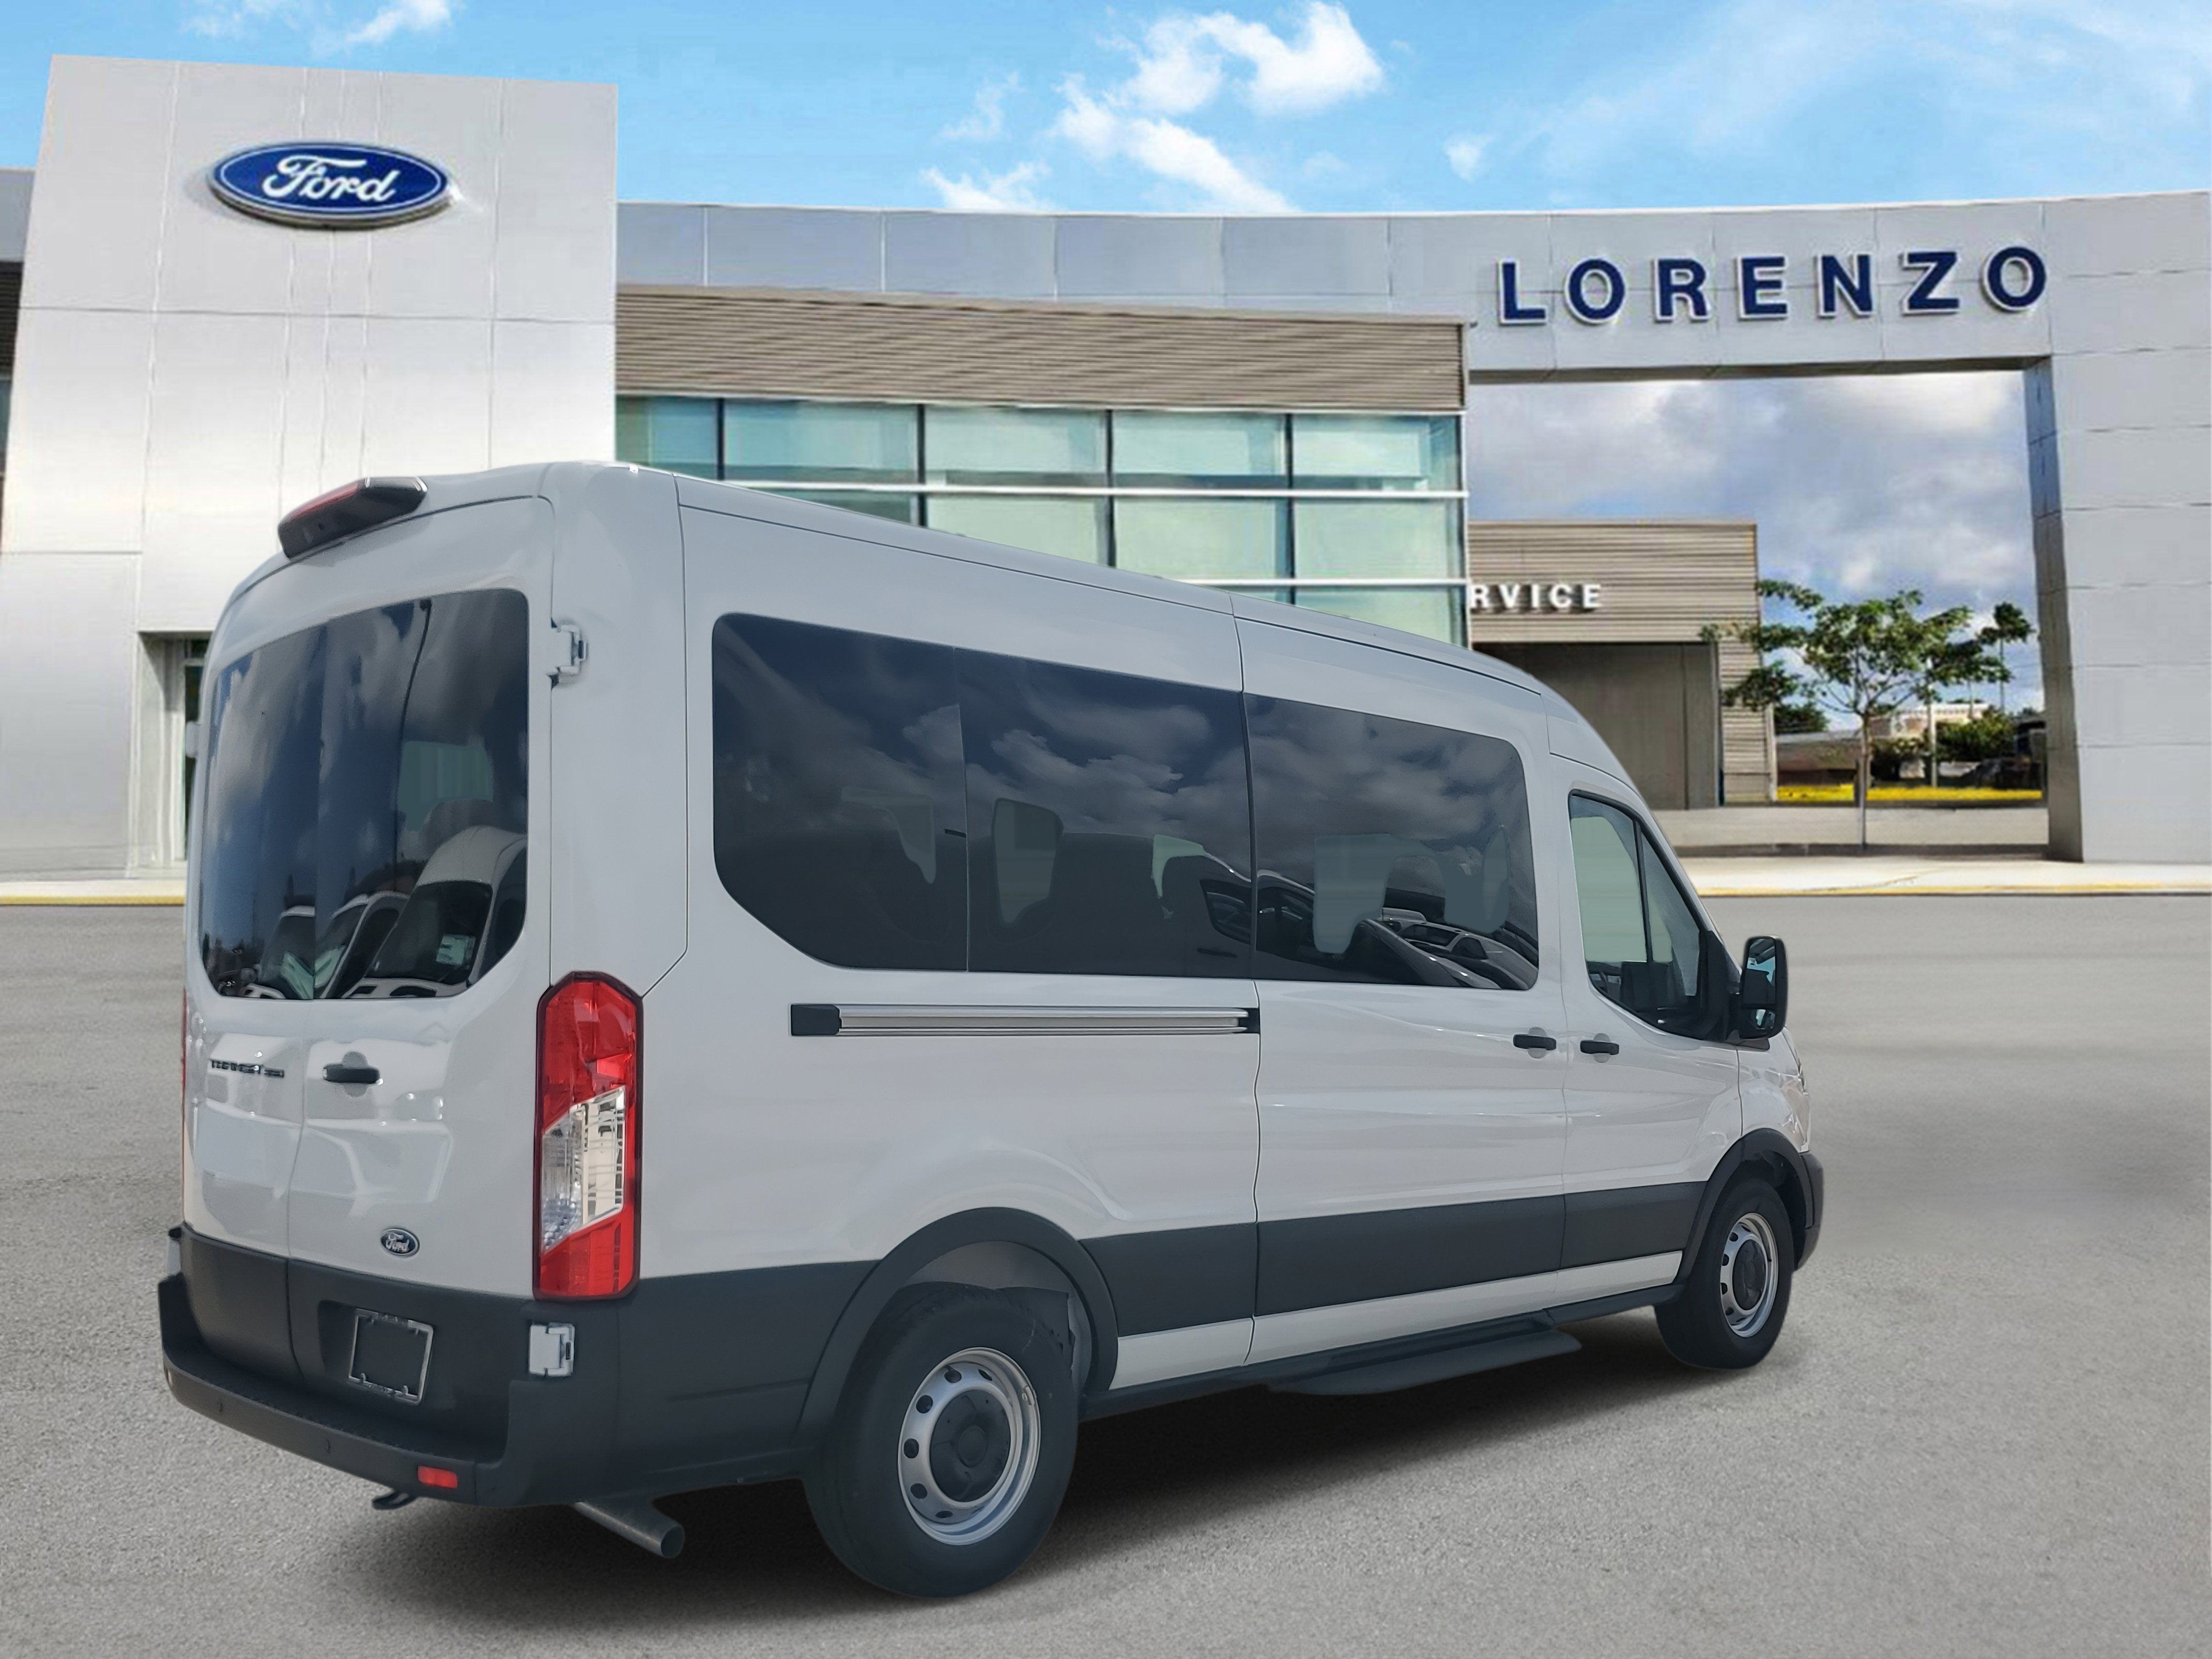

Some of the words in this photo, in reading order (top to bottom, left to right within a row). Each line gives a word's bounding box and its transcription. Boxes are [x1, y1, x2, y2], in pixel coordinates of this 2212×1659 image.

[262, 154, 401, 202] Ford
[1499, 247, 2047, 322] LORENZO
[385, 1232, 410, 1252] Ford
